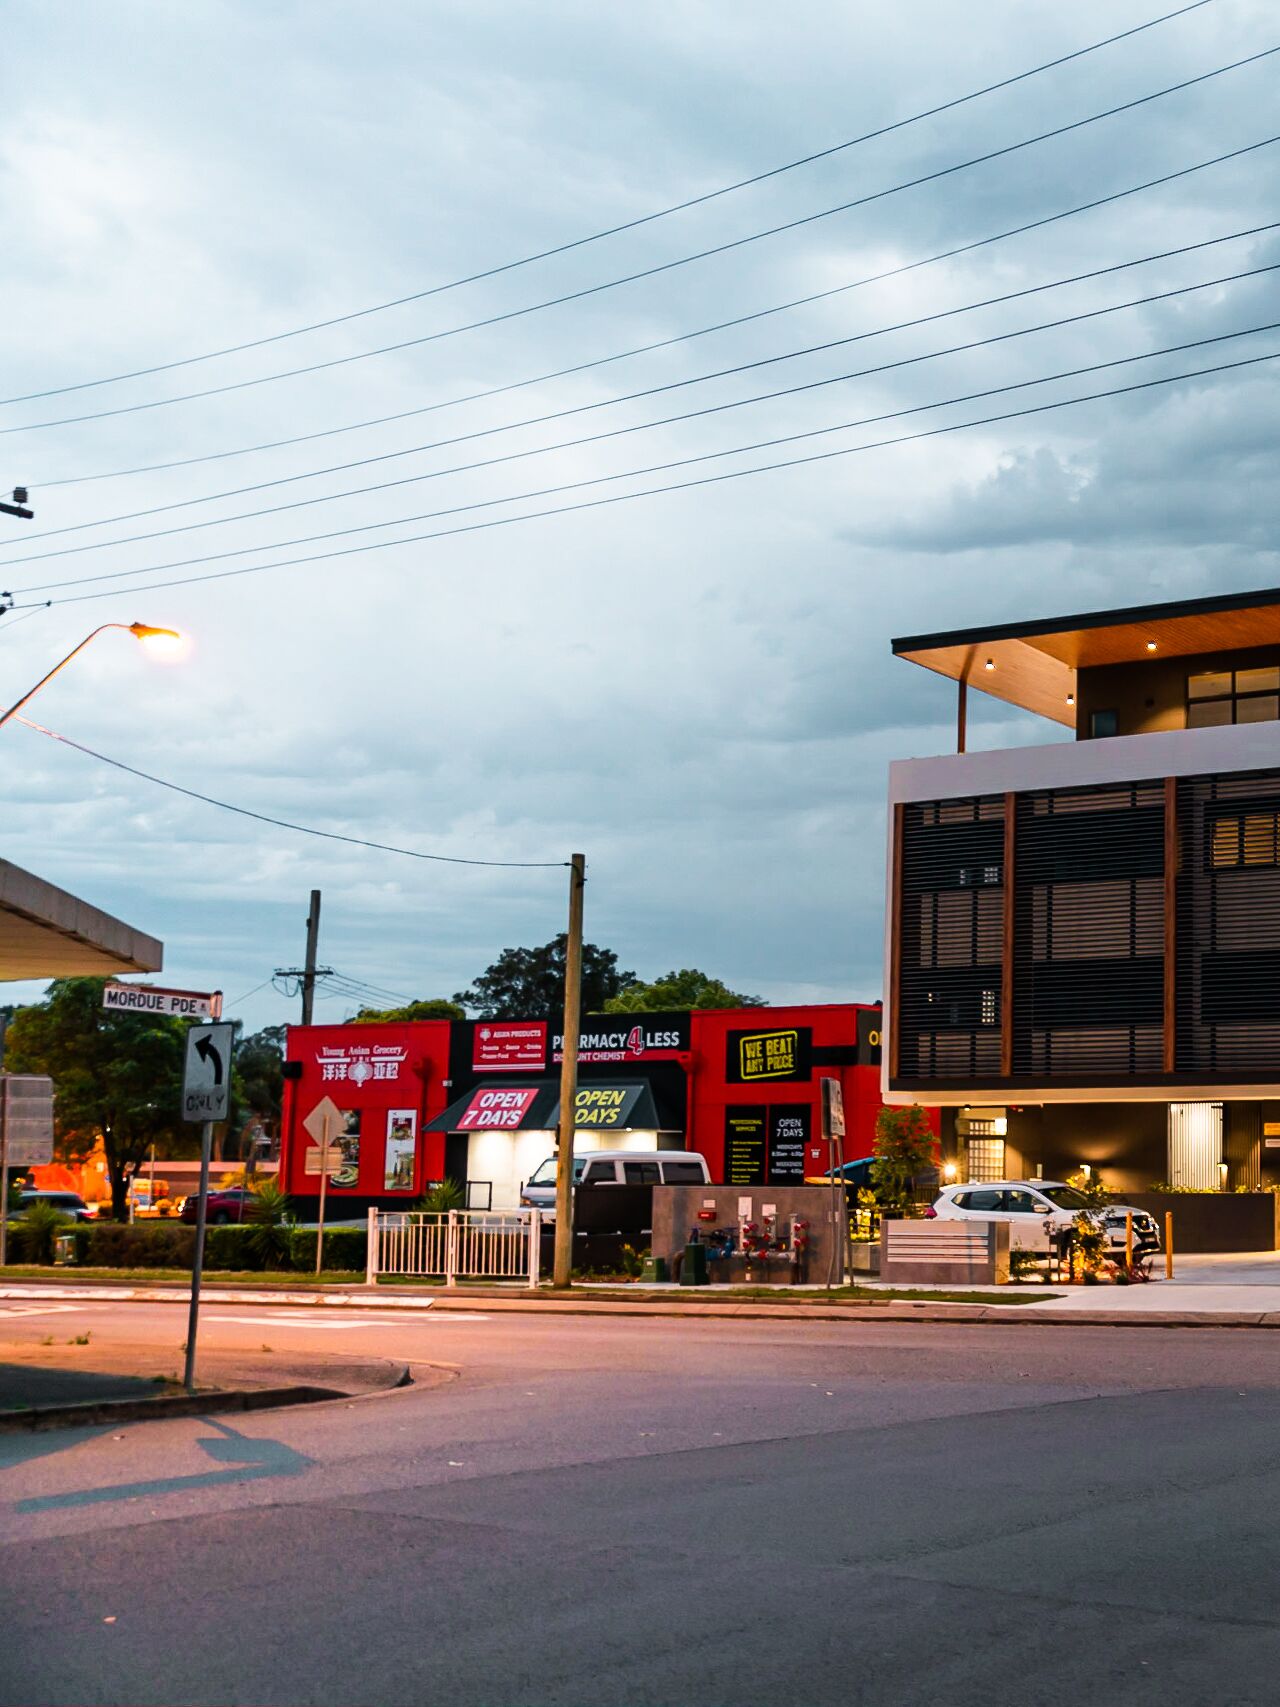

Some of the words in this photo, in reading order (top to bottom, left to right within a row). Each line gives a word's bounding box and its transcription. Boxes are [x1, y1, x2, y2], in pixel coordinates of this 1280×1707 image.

[107, 990, 165, 1010] MORDUE
[170, 998, 198, 1014] PDE
[552, 1033, 627, 1050] PRMACY
[627, 1025, 645, 1056] 4
[646, 1031, 680, 1047] LESS
[745, 1041, 763, 1059] WE
[765, 1037, 793, 1057] BEAT
[372, 1044, 403, 1056] Grocery
[592, 1050, 627, 1061] CHEMIST
[745, 1057, 764, 1074] ANY
[766, 1053, 795, 1071] PRICE
[479, 1092, 528, 1107] OPEN
[574, 1090, 627, 1107] OPEN
[463, 1110, 479, 1126] 7
[477, 1110, 523, 1126] DAYS
[574, 1108, 621, 1124] DAYS
[778, 1118, 802, 1128] OPEN
[776, 1128, 782, 1137] 7
[782, 1128, 804, 1137] DAYS
